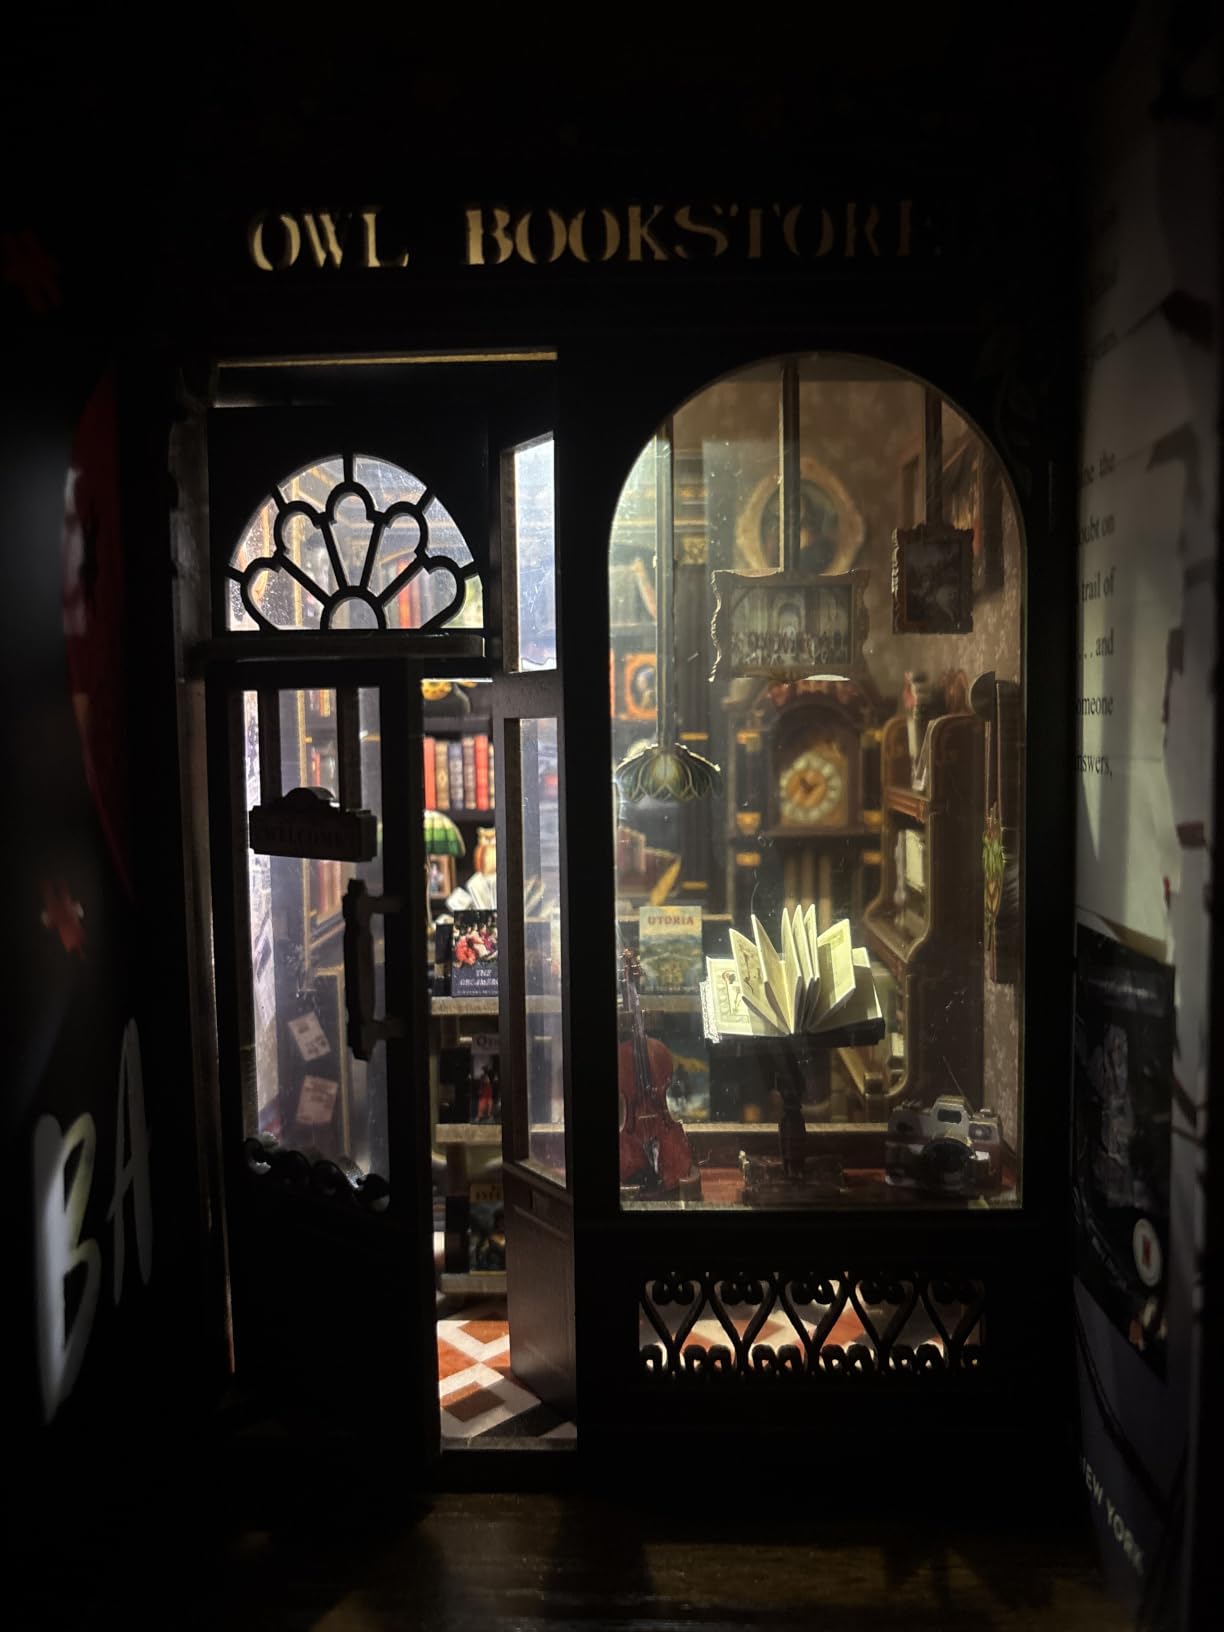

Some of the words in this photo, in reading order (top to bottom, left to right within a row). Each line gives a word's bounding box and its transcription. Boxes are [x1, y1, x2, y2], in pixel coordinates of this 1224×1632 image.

[248, 207, 409, 271] OWL
[1076, 514, 1101, 544] oubt
[1081, 569, 1101, 601] trail
[1103, 566, 1117, 596] of
[1095, 627, 1114, 656] and
[1105, 1496, 1144, 1577] YORK
